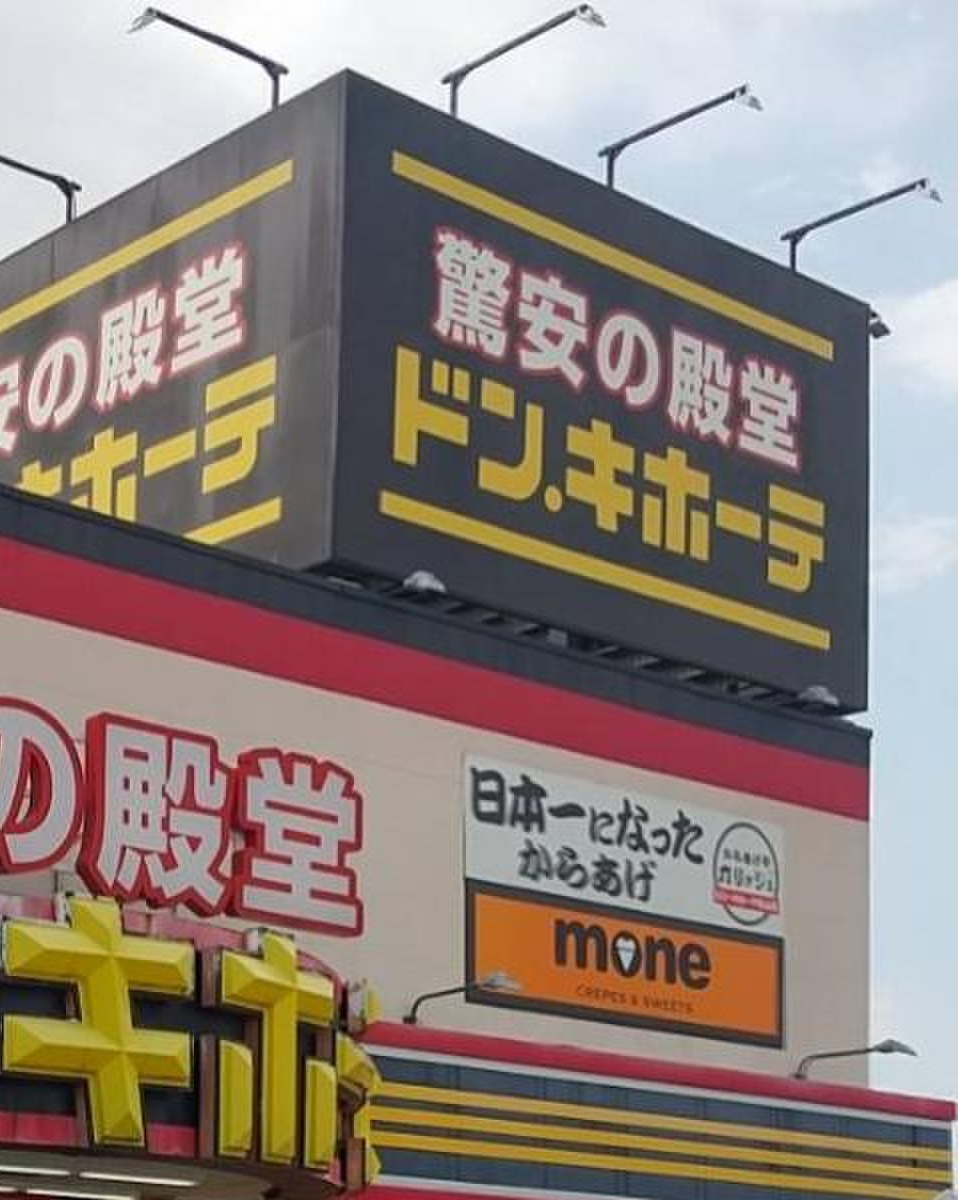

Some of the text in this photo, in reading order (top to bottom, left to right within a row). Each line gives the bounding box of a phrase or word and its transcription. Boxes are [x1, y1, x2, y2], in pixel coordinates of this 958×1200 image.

[433, 226, 802, 474] 驚安の殿堂
[470, 765, 704, 864] 日本一になった
[518, 839, 656, 902] からあげ
[554, 919, 712, 991] mone
